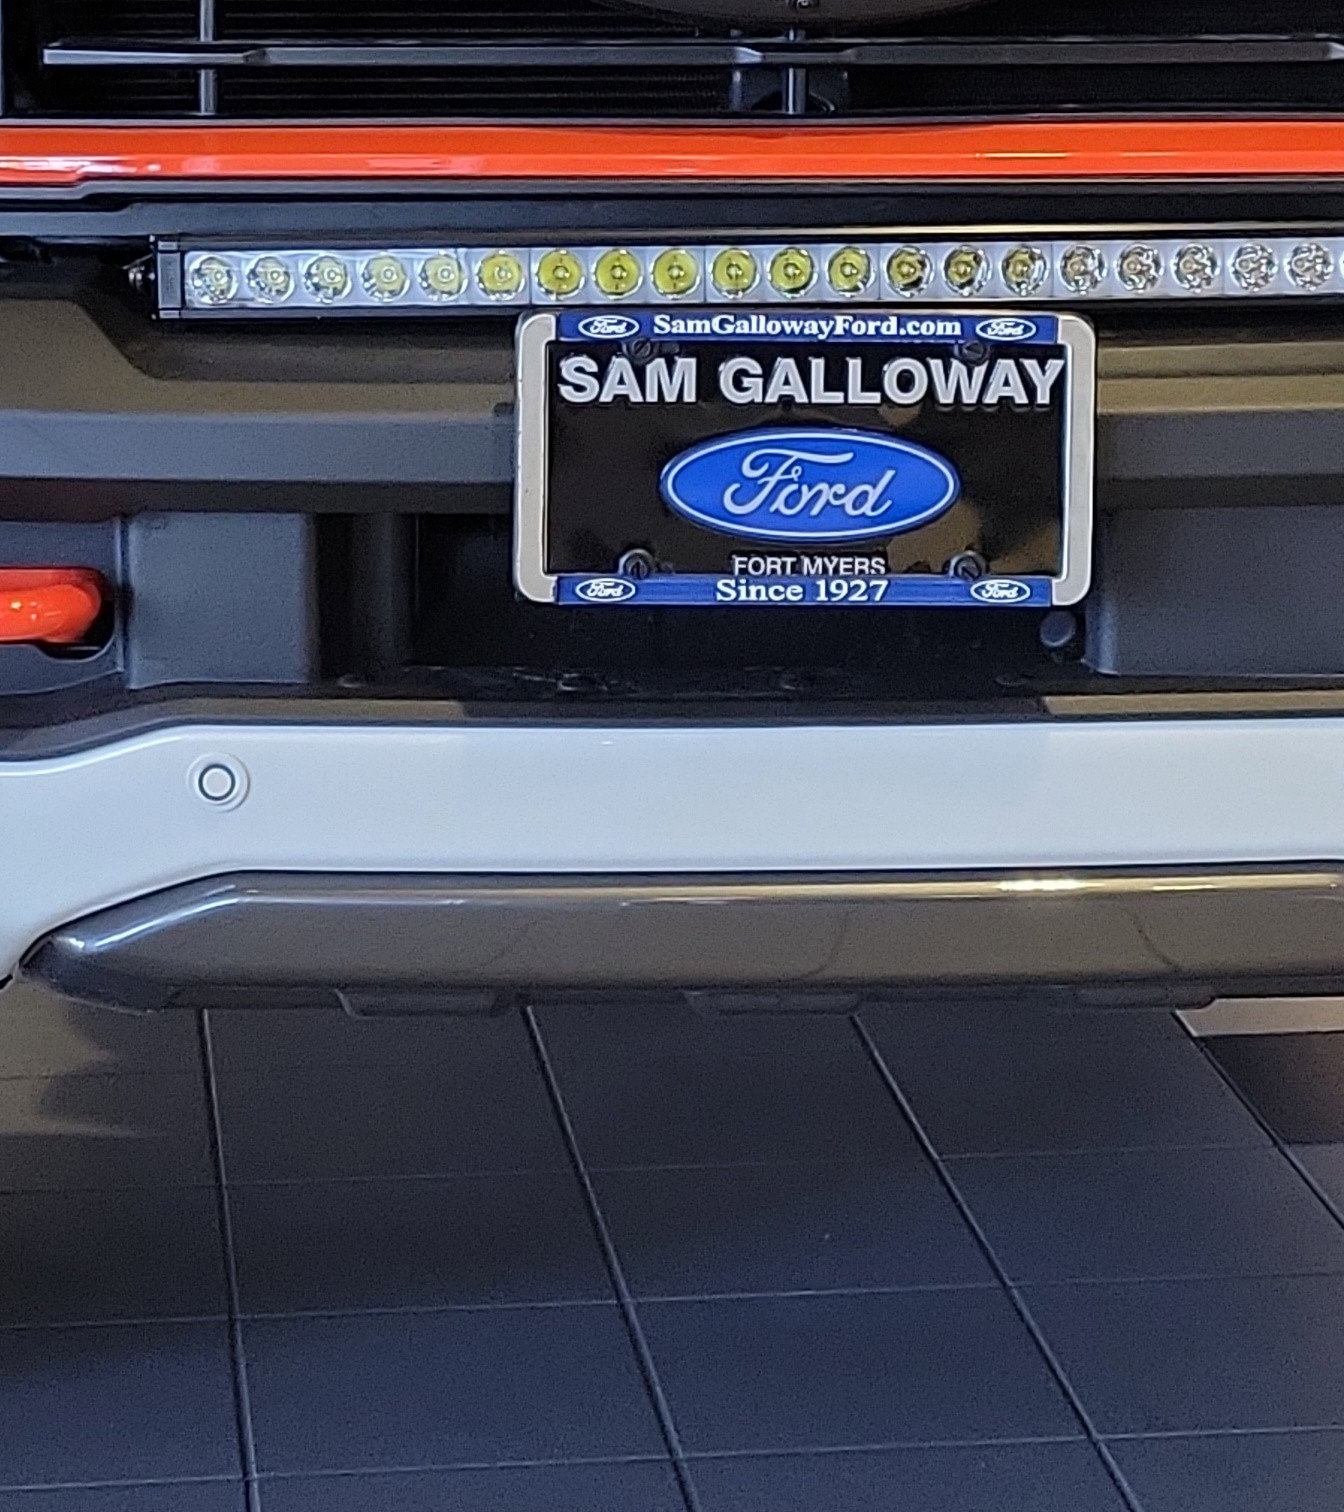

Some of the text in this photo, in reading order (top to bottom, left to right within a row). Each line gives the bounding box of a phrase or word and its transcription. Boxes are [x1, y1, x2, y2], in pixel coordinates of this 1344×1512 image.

[653, 314, 962, 339] SamGallowayFord.com
[557, 355, 1065, 406] SAM GALLOWAY
[721, 447, 897, 518] Ford
[732, 555, 887, 576] FORT MYERS
[716, 578, 804, 601] Since
[815, 578, 889, 602] 1927
